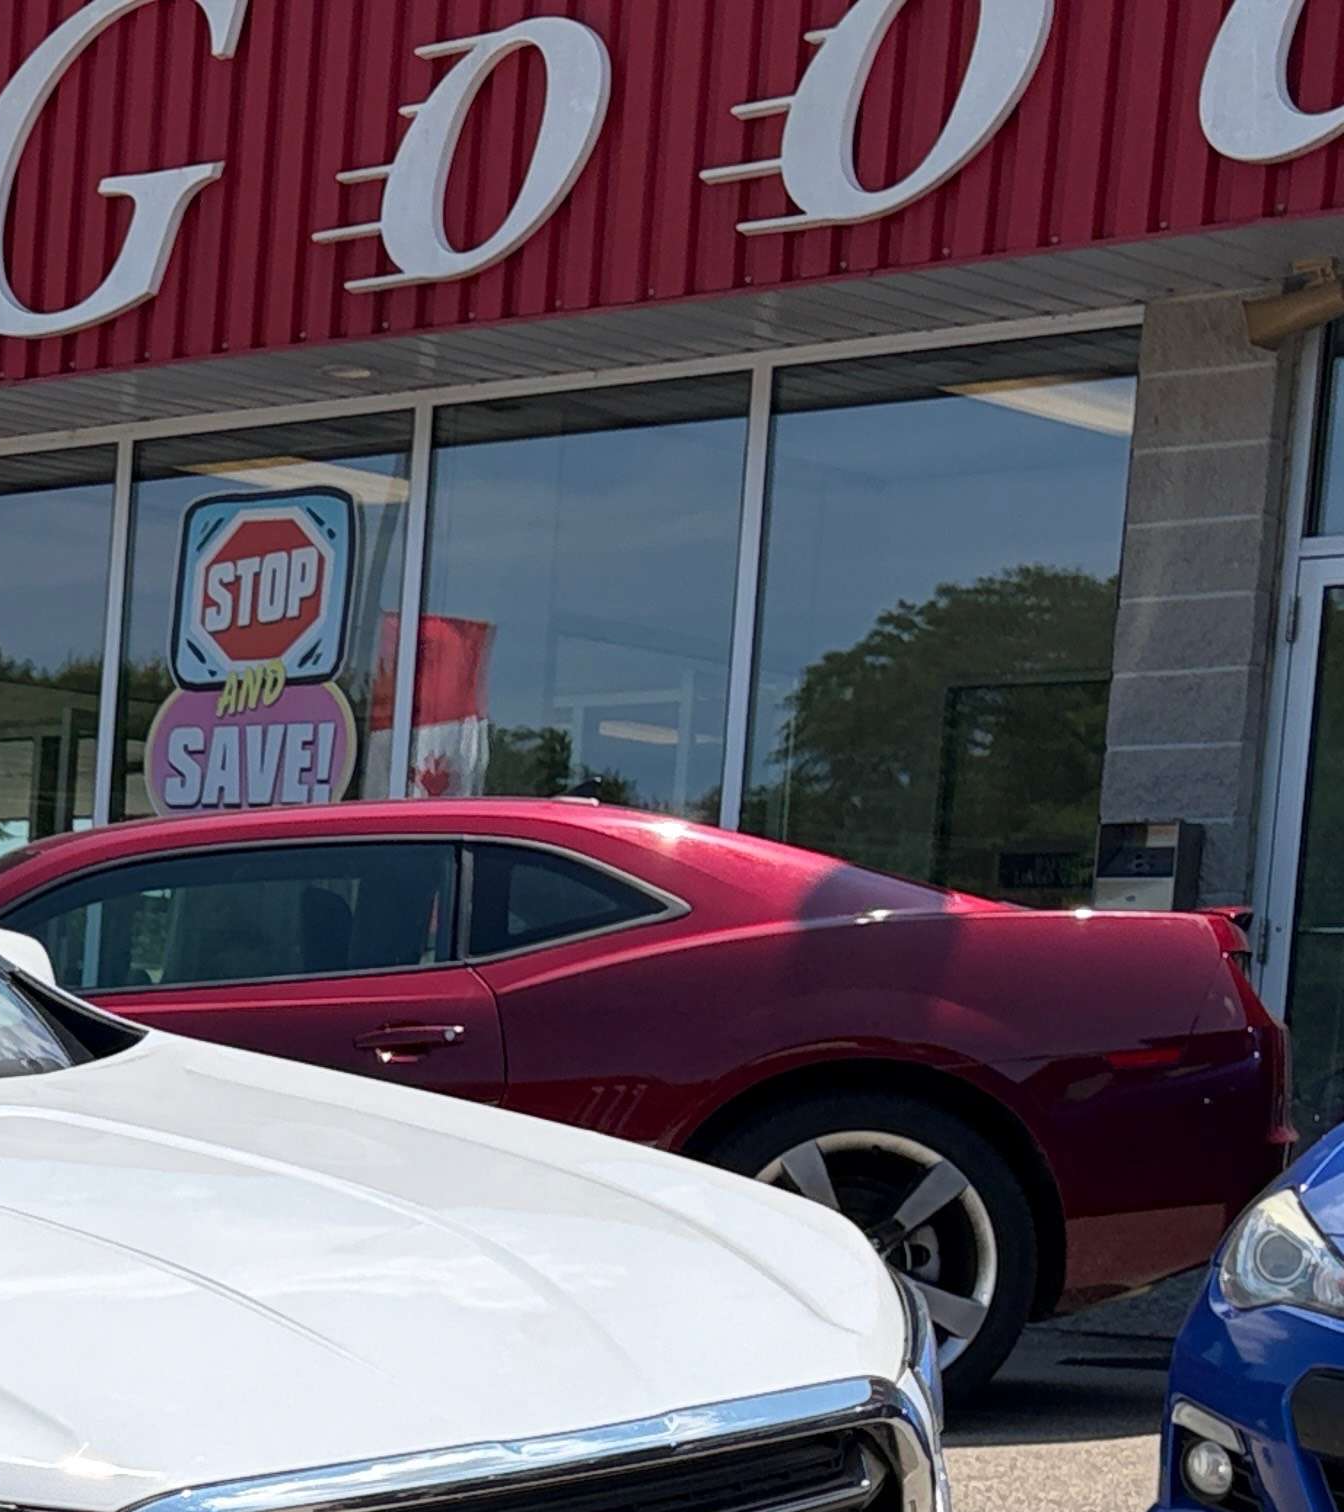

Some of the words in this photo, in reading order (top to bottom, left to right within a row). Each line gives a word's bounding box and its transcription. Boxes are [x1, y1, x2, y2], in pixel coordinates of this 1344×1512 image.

[204, 546, 318, 632] STOP
[216, 659, 286, 718] AND
[165, 722, 335, 809] SAVE!
